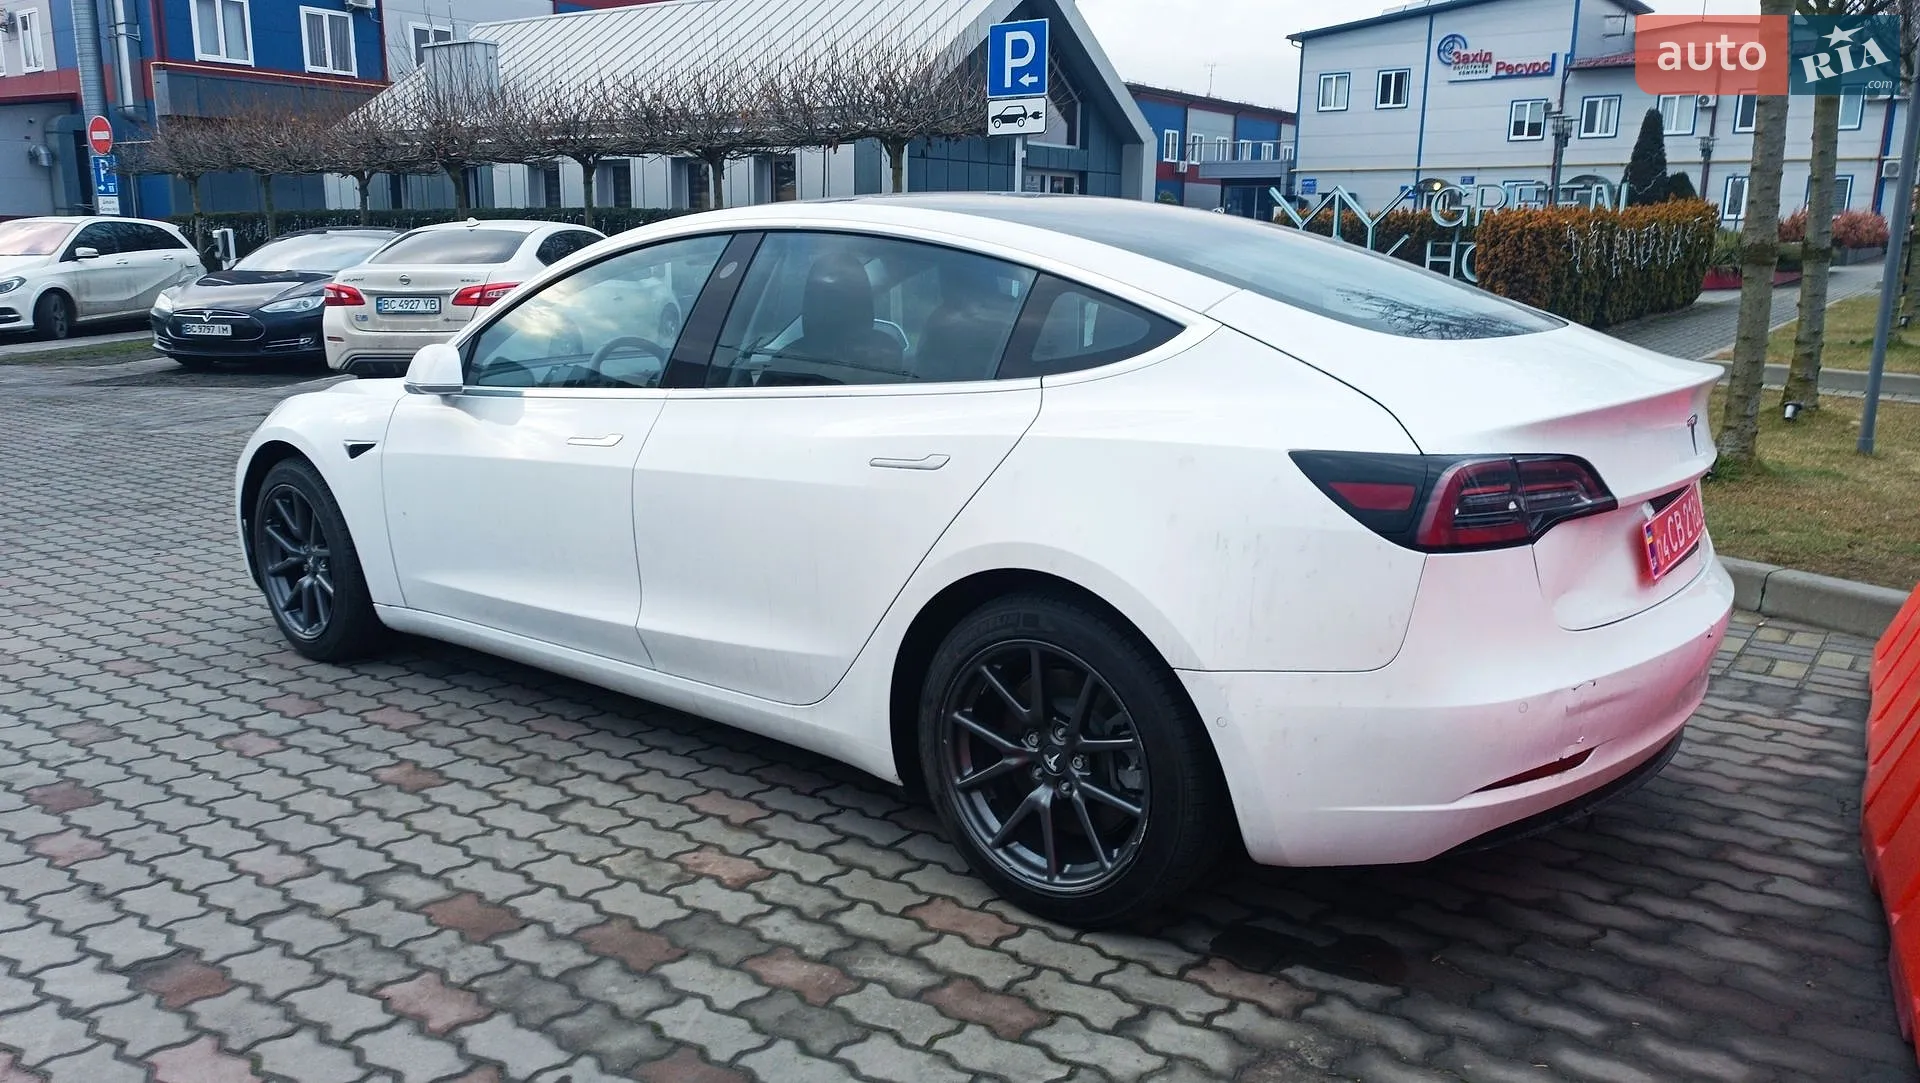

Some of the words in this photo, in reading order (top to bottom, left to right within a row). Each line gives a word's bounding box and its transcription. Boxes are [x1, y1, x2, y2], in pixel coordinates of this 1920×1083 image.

[1004, 31, 1036, 88] P
[1452, 49, 1492, 64] Захід
[1495, 60, 1551, 76] Ресурс
[383, 300, 396, 310] BC
[398, 300, 420, 310] 4927
[424, 300, 437, 310] YB
[185, 324, 197, 333] BC
